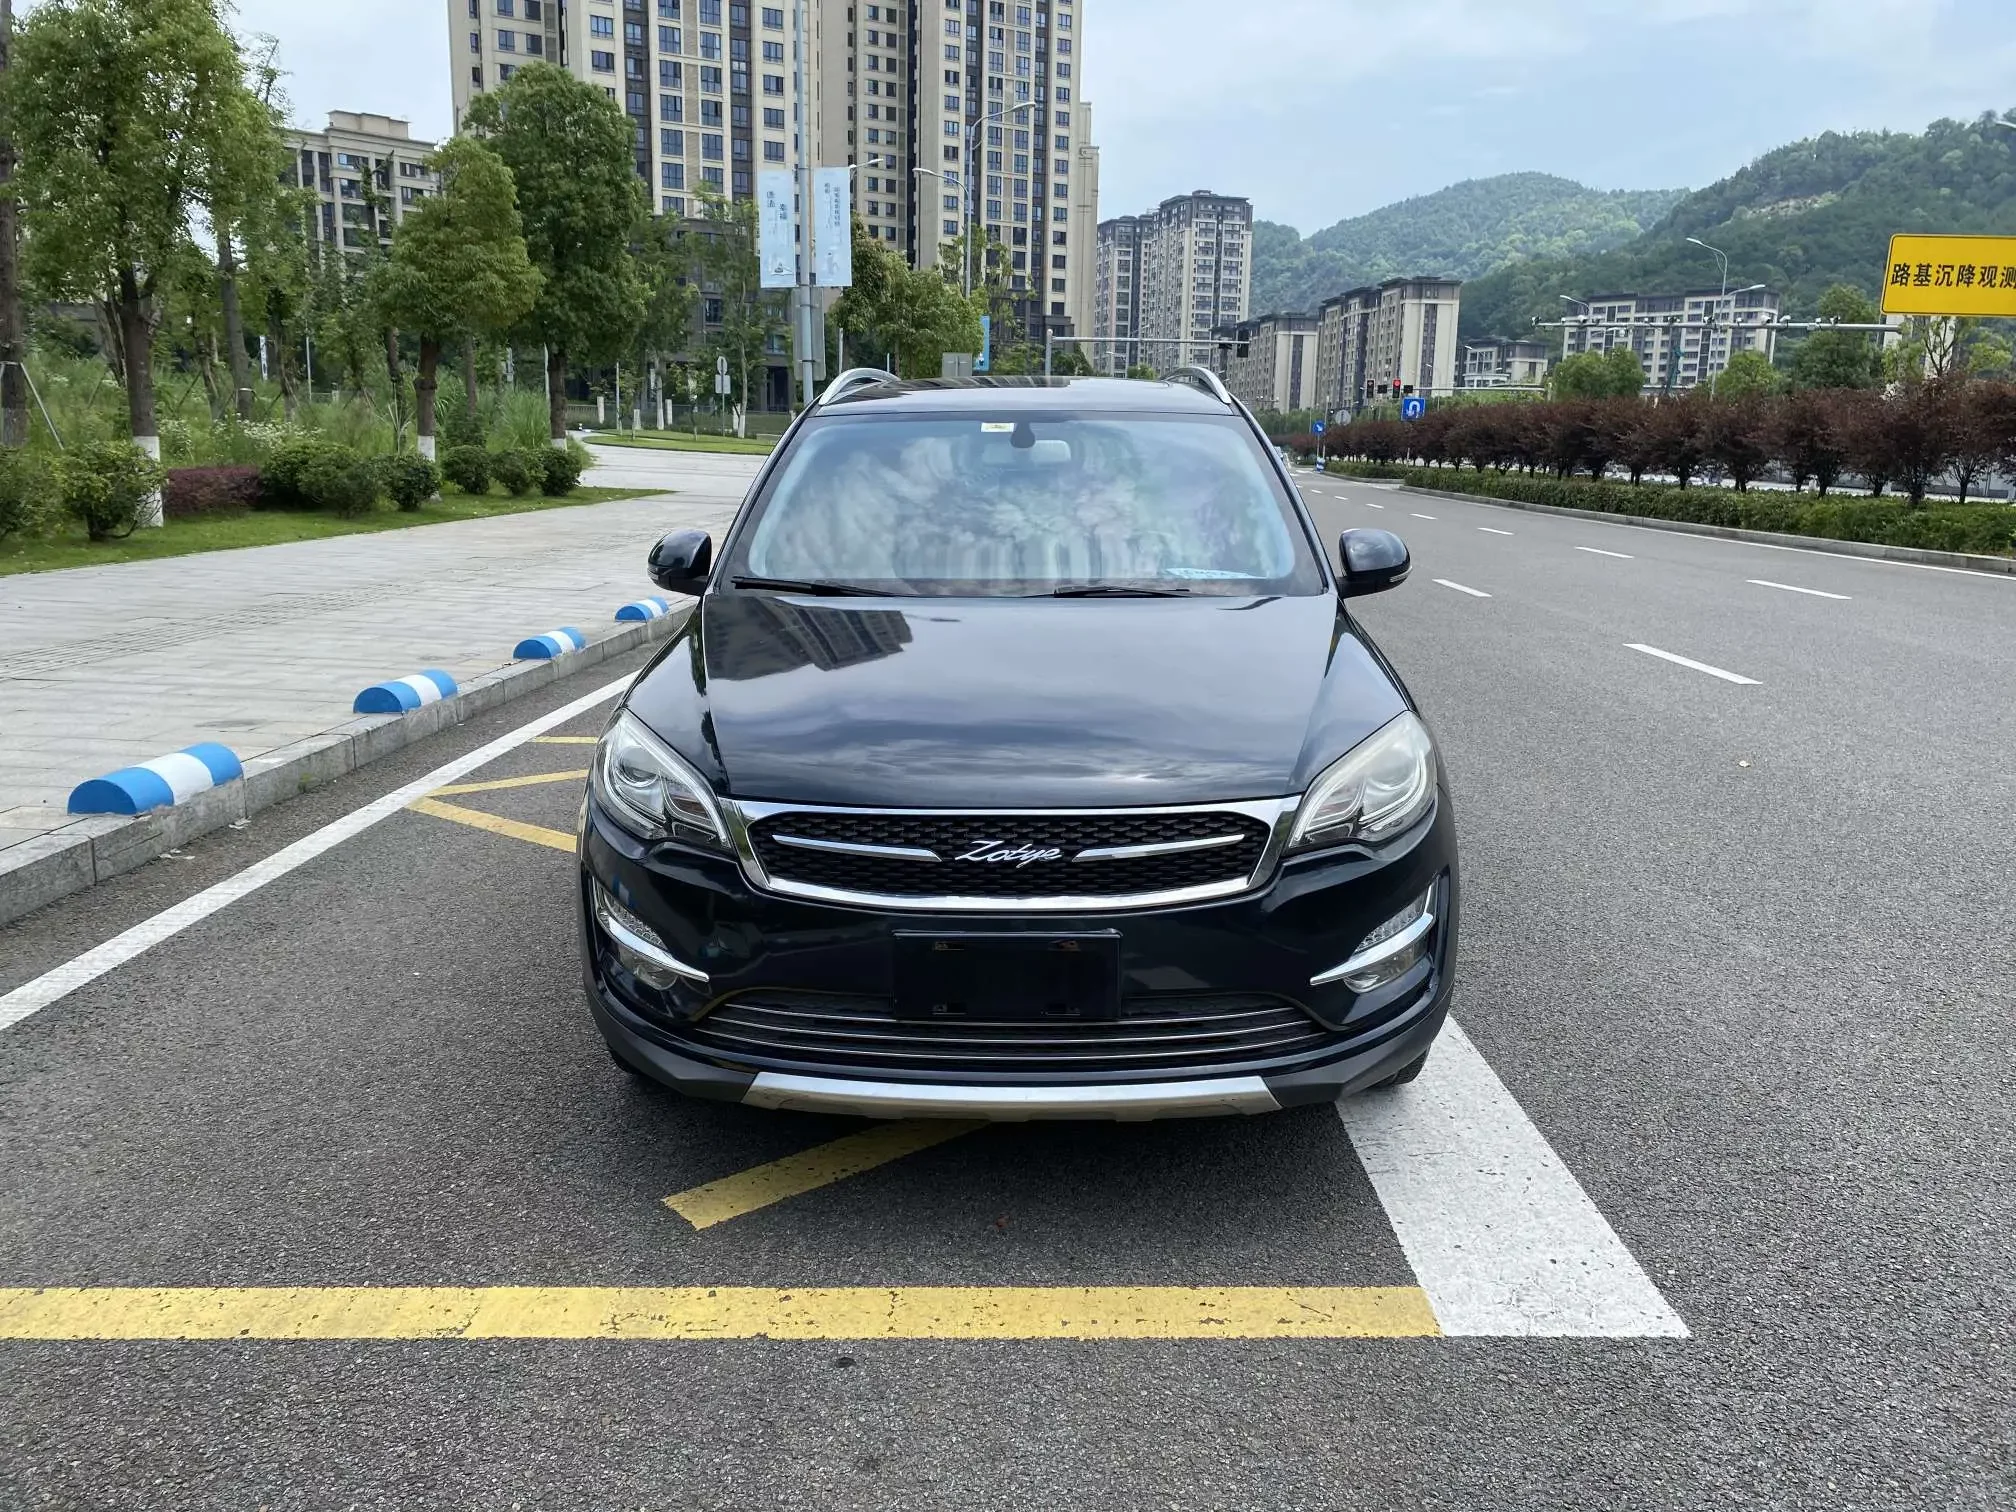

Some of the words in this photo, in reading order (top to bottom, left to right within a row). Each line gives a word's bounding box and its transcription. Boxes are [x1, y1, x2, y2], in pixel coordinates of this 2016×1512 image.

[1890, 262, 2016, 289] 路基沉降观测
[954, 840, 1063, 868] Zotye
